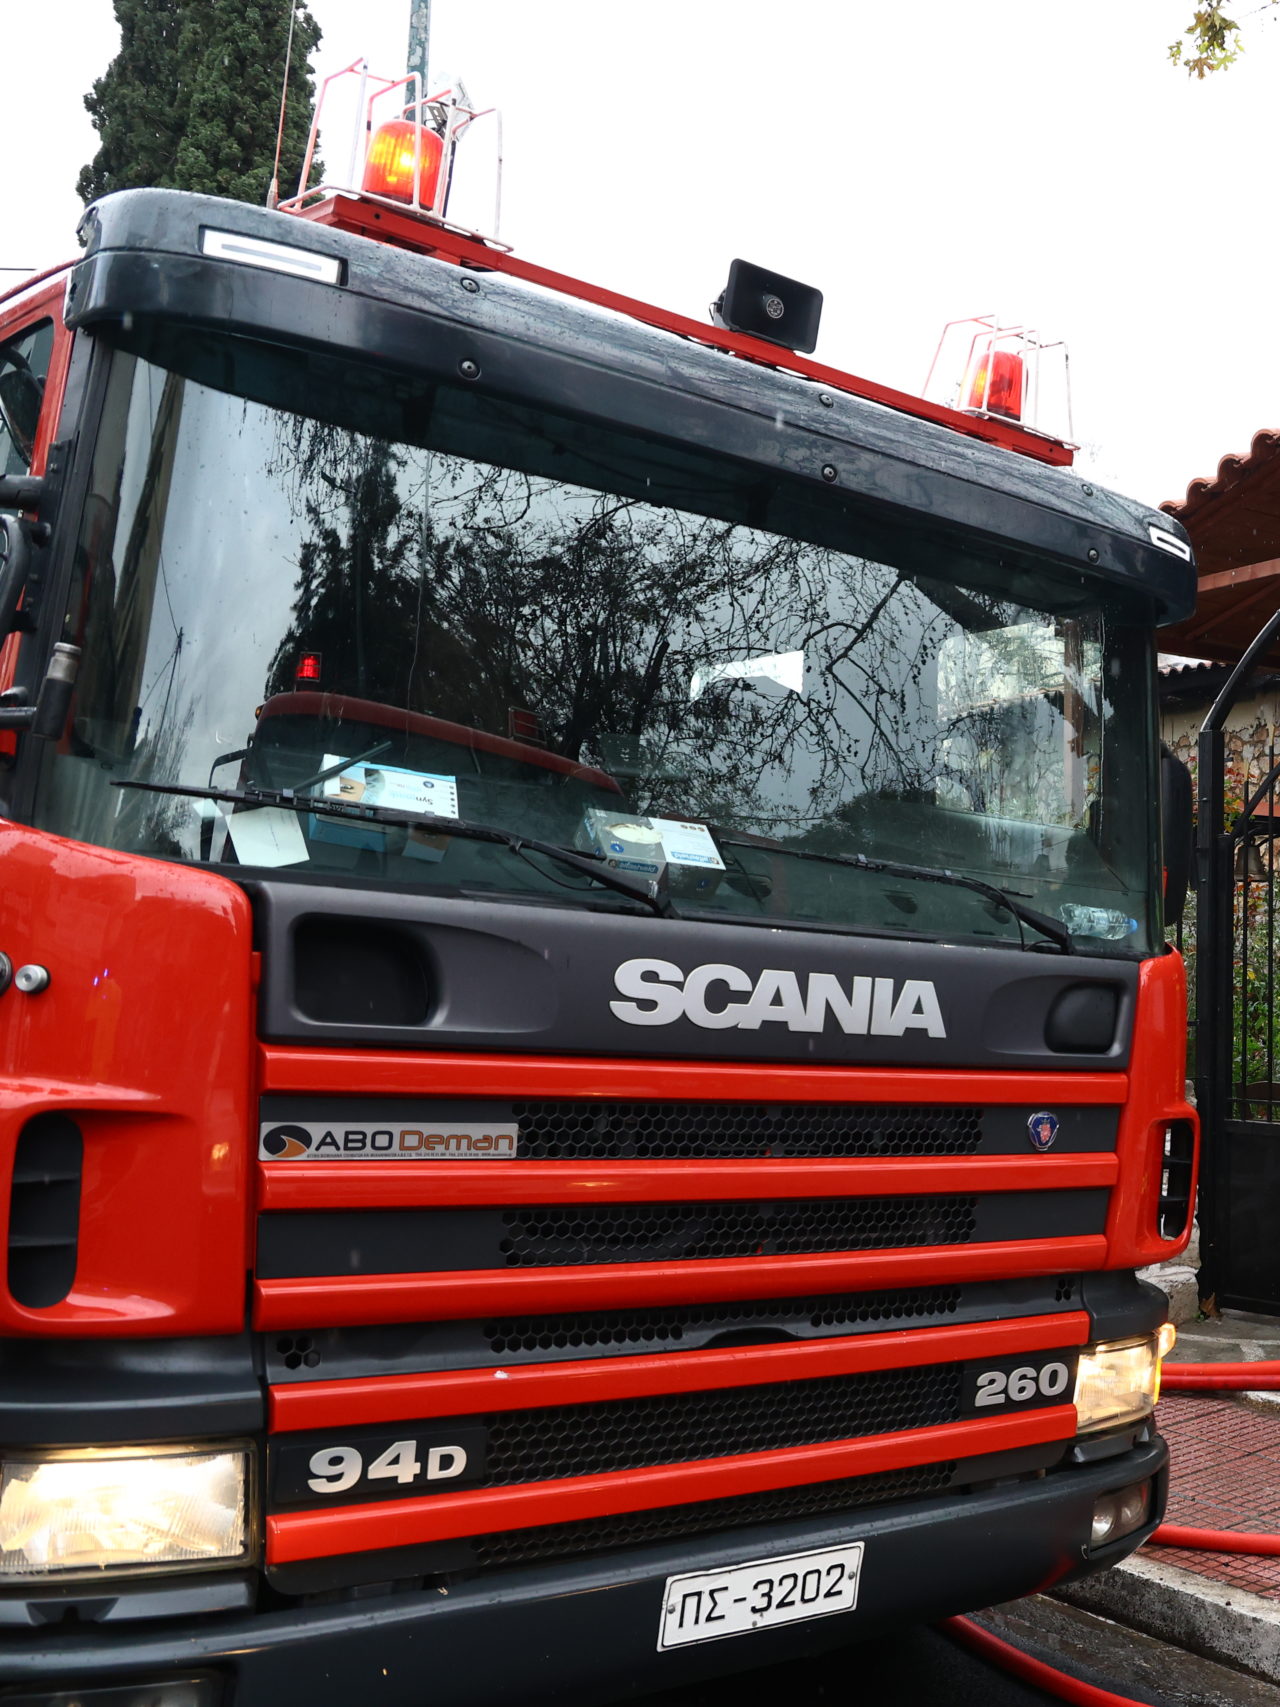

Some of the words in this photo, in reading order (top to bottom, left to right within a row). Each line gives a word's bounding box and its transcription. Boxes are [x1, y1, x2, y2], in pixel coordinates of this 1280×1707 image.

[609, 958, 947, 1038] SCANIA
[315, 1130, 394, 1152] ABO
[399, 1130, 514, 1151] Deman
[974, 1362, 1069, 1407] 260
[307, 1440, 467, 1493] 94D
[678, 1563, 845, 1628] ΠΣ-3202
